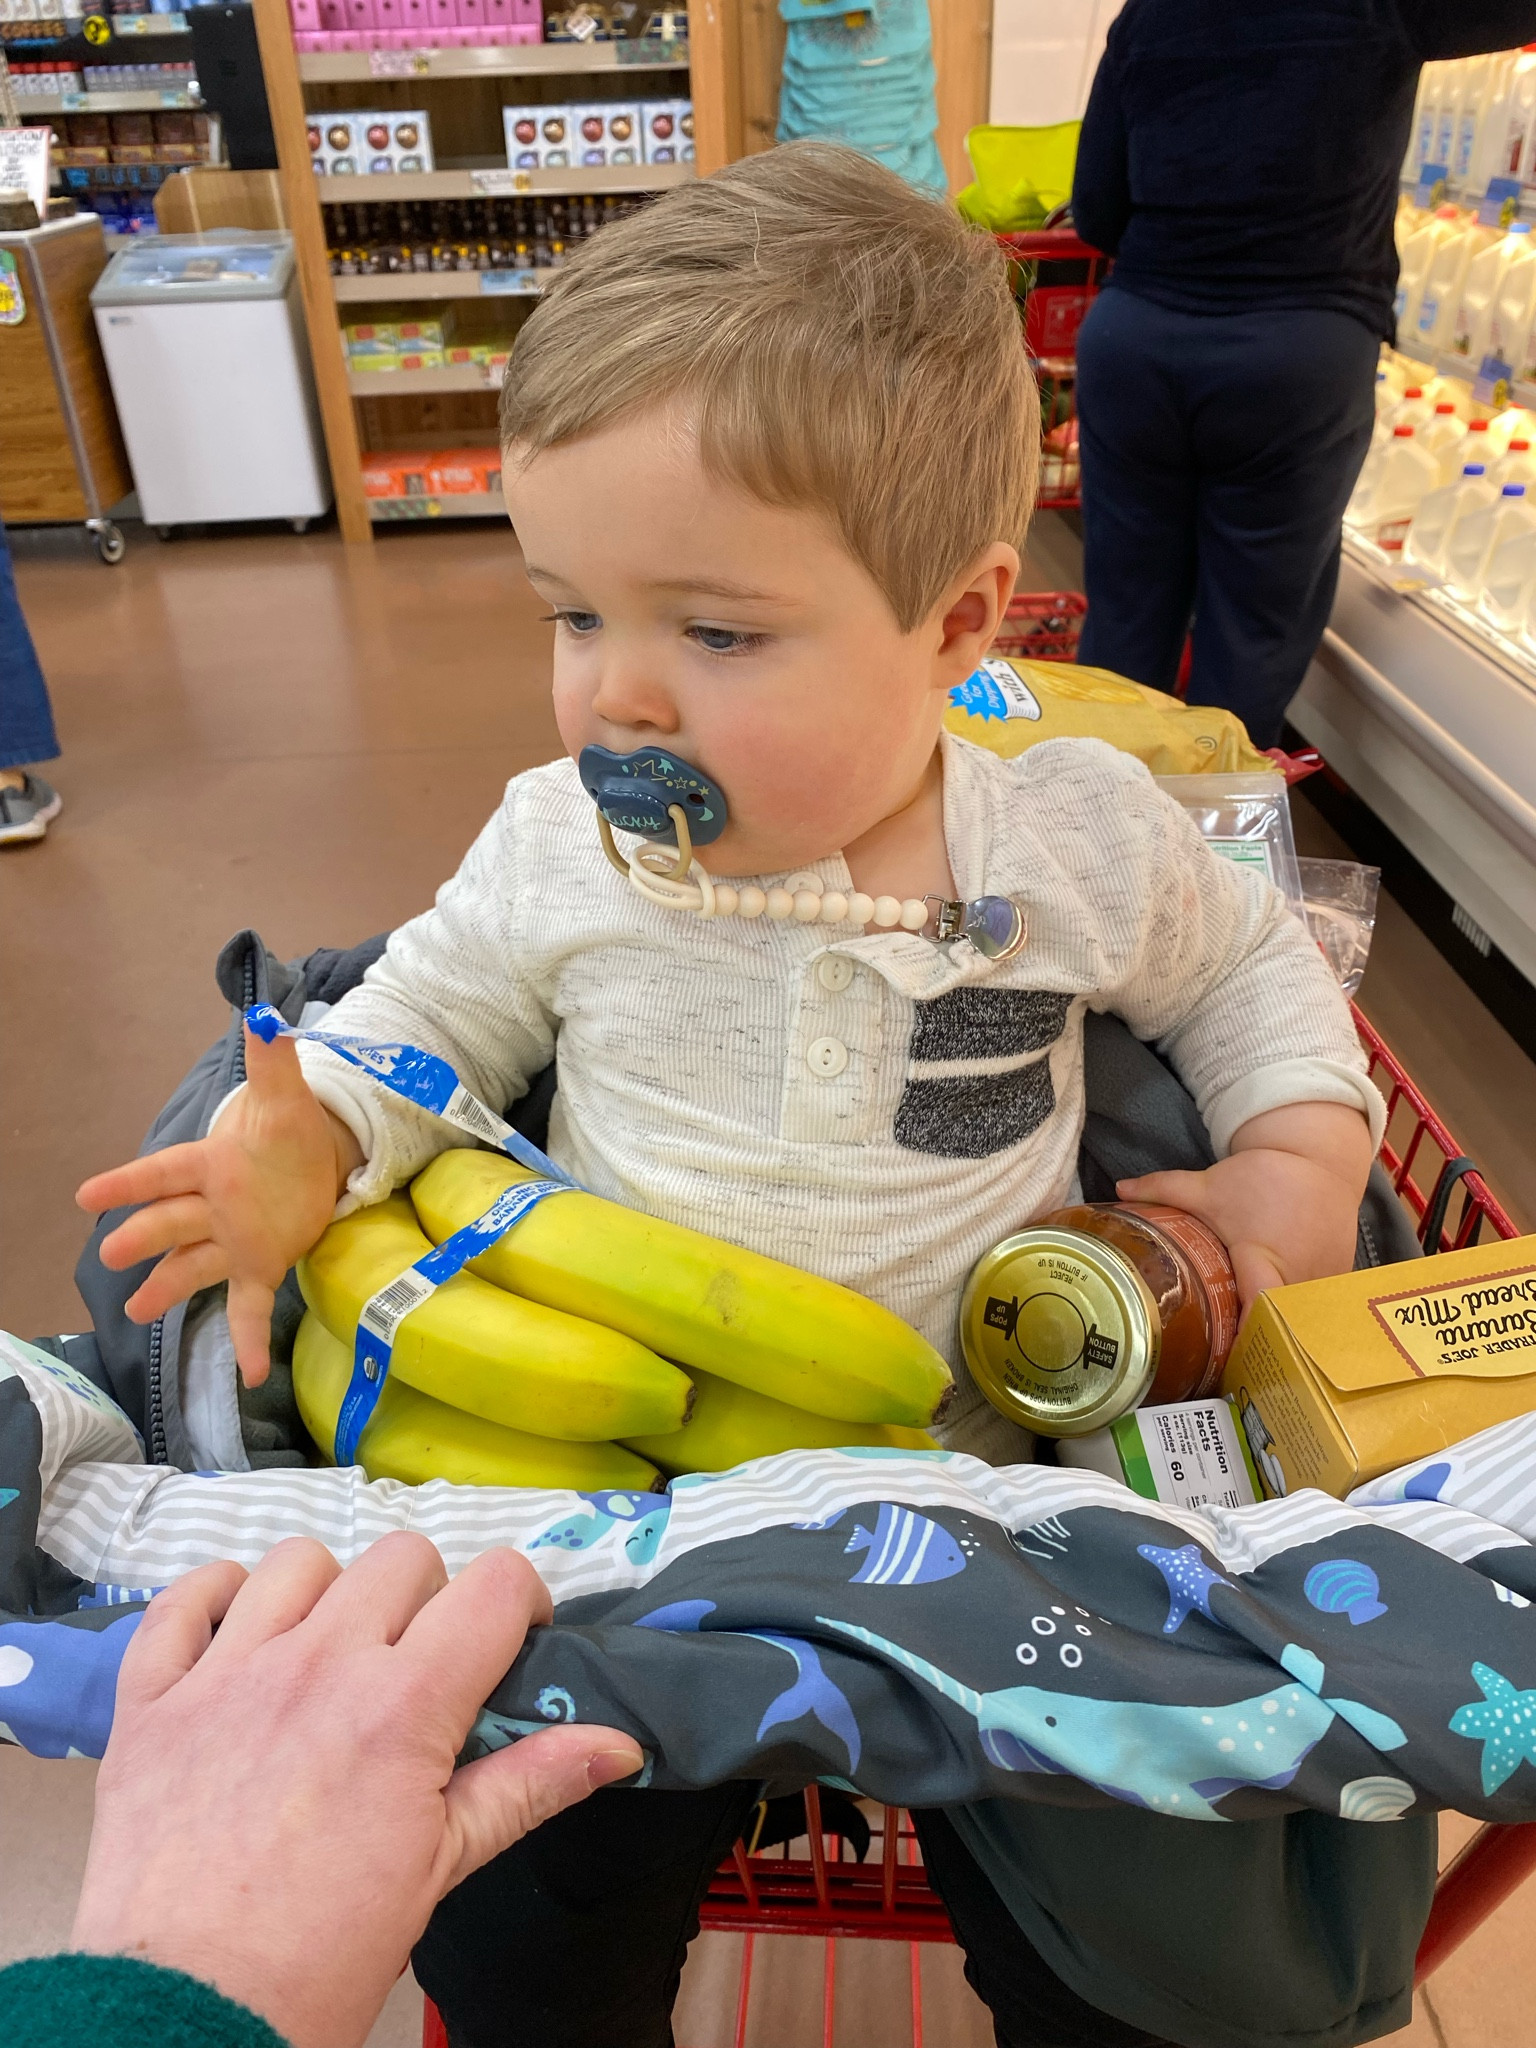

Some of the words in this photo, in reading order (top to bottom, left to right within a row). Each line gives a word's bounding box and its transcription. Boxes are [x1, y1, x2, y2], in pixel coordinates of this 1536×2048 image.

[994, 673, 1028, 702] with
[491, 1186, 535, 1217] ORGANIC
[492, 1190, 538, 1226] BANANES
[1037, 1258, 1047, 1268] UP
[1048, 1259, 1055, 1268] IS
[1056, 1260, 1081, 1277] BUTTON
[1050, 1270, 1074, 1285] REJECT
[1080, 1274, 1089, 1282] IF
[1461, 1279, 1536, 1316] Bread
[990, 1313, 1008, 1326] POPS
[996, 1305, 1006, 1314] UP
[1394, 1297, 1462, 1327] Mix
[1435, 1309, 1536, 1346] Banana
[1087, 1348, 1113, 1364] SAFETY
[1088, 1337, 1116, 1353] BUTTON
[1004, 1358, 1025, 1382] BROKEN
[1025, 1378, 1032, 1387] IS
[1034, 1383, 1049, 1394] SEAL
[1051, 1382, 1079, 1395] ORIGINAL
[1279, 1366, 1294, 1397] Banana
[1294, 1395, 1306, 1421] Bread
[1306, 1420, 1315, 1437] Mix
[1160, 1428, 1170, 1451] serving
[1178, 1414, 1190, 1439] Serving
[1186, 1441, 1194, 1455] size
[1194, 1411, 1212, 1452] Facts
[1205, 1410, 1228, 1474] Nutrition
[1161, 1415, 1178, 1453] Calories
[1170, 1460, 1185, 1482] 60
